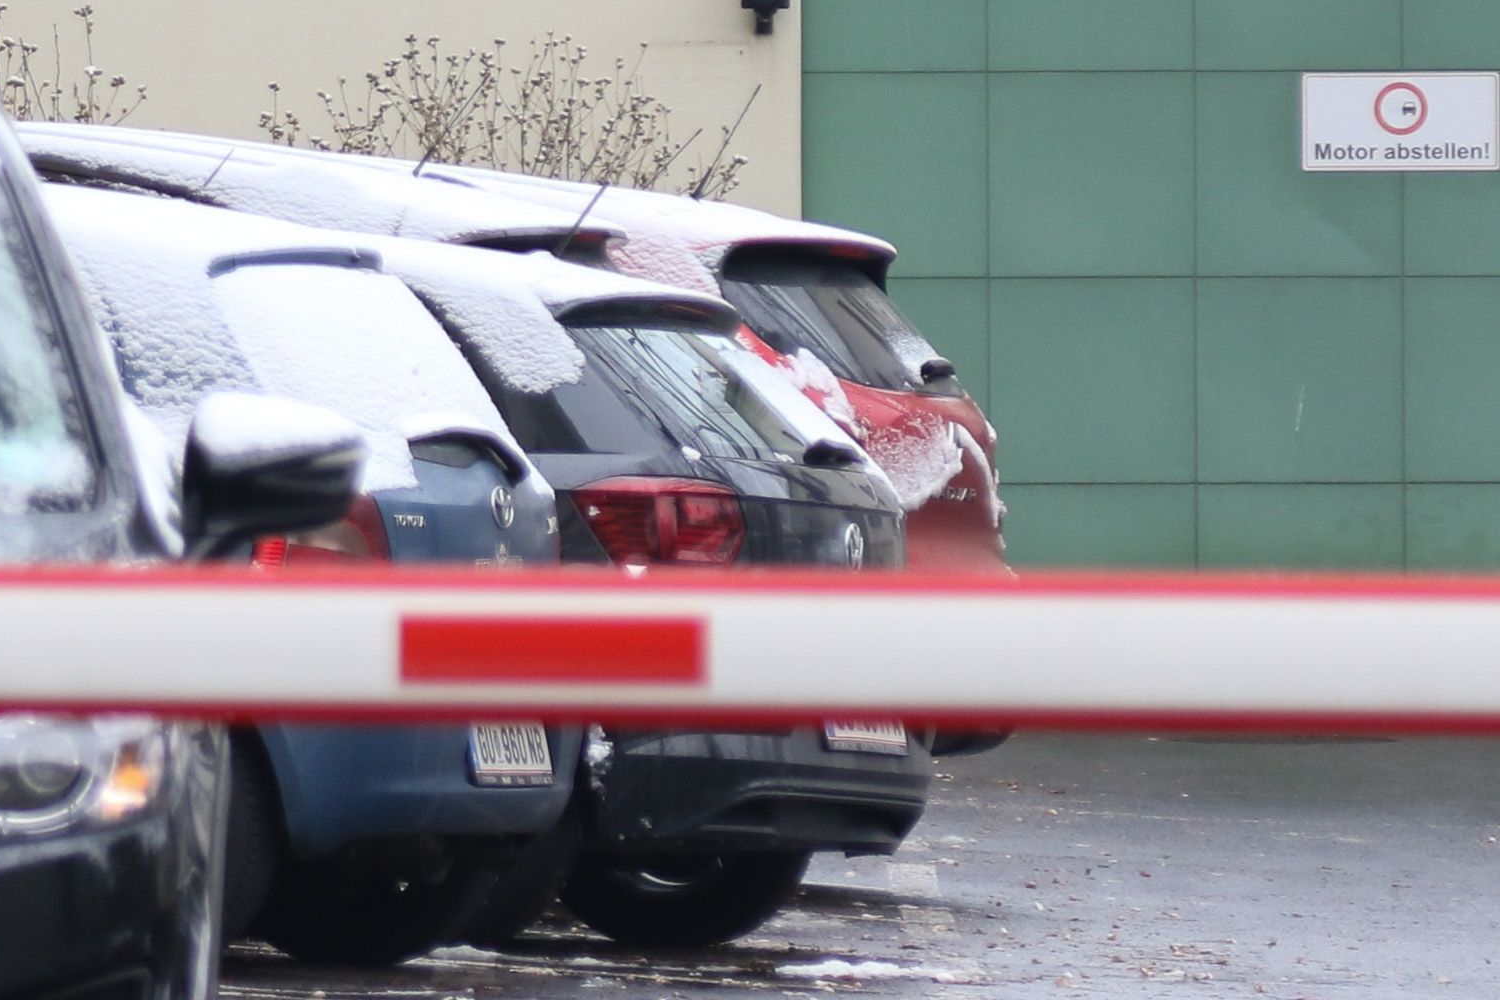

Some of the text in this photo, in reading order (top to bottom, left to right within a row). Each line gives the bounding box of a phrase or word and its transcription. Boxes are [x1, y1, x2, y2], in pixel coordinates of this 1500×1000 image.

[1314, 142, 1491, 161] Motor abstellen!
[393, 514, 426, 529] TOYOTA
[477, 725, 546, 765] GU 960 NB
